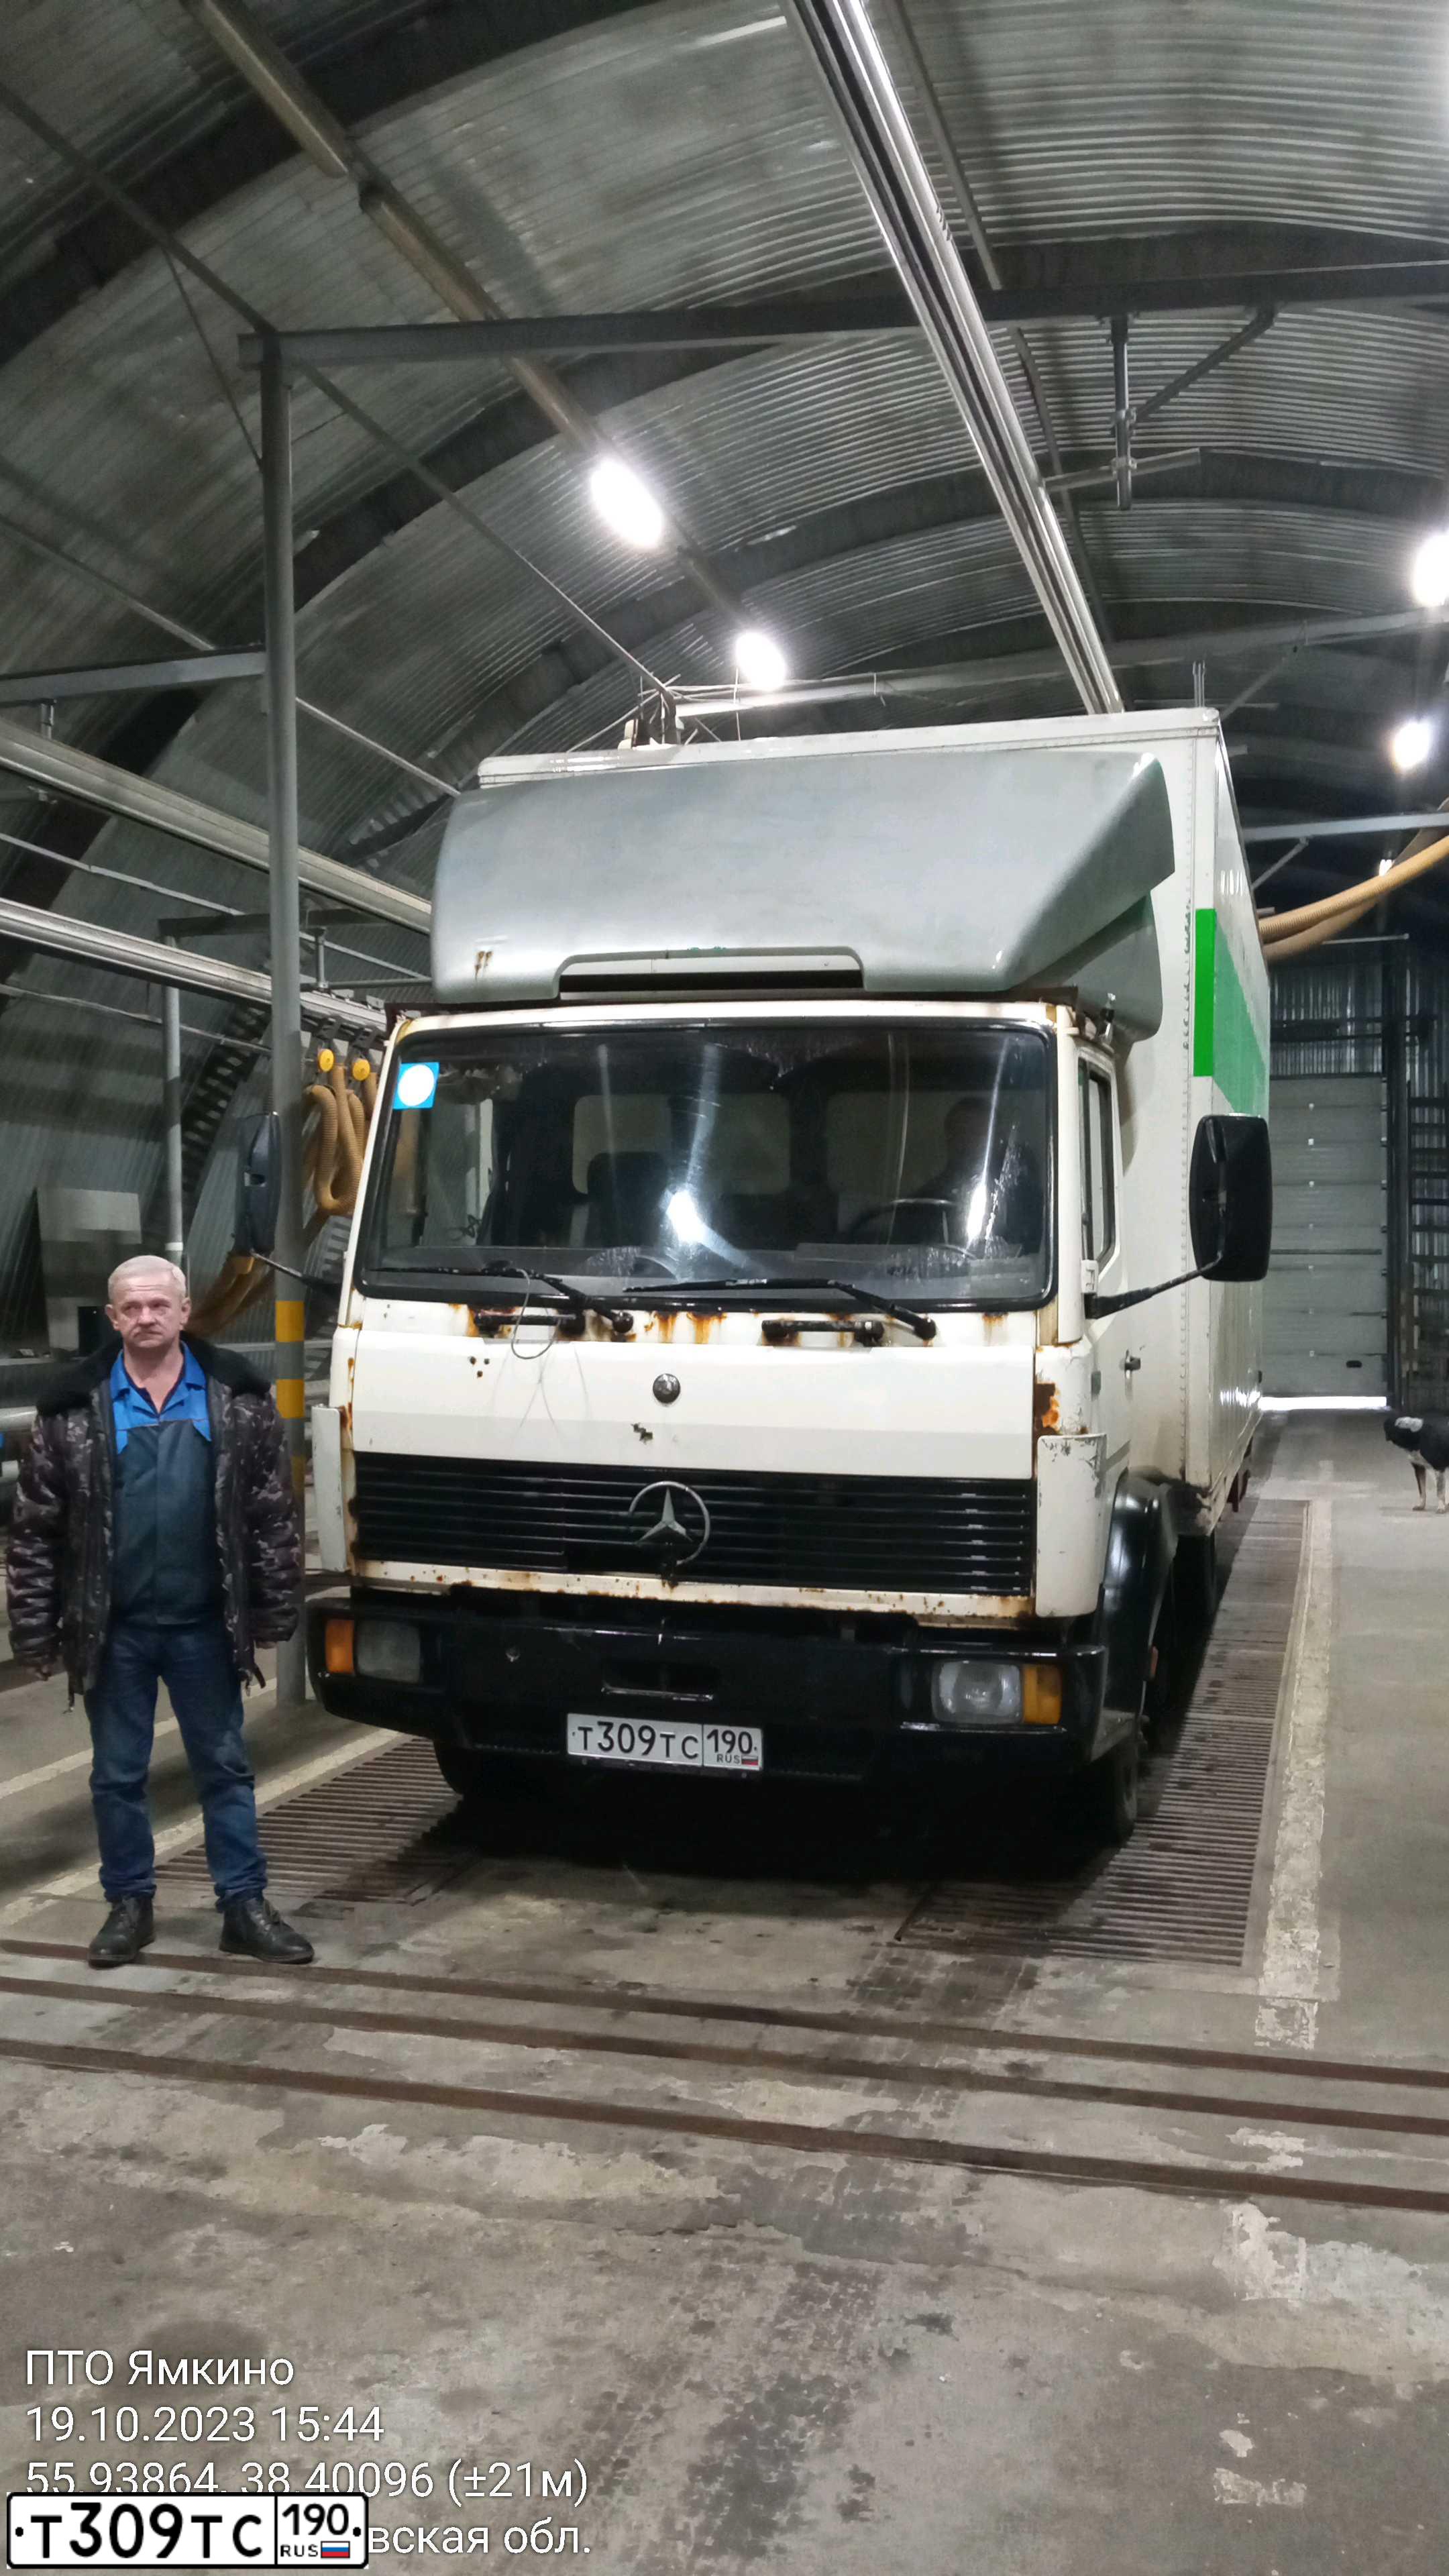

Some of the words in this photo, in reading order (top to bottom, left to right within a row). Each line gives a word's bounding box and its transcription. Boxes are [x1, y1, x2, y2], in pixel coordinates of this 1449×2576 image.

[578, 1721, 699, 1759] Т309ТС
[706, 1729, 753, 1754] 190
[716, 1754, 740, 1764] RUS
